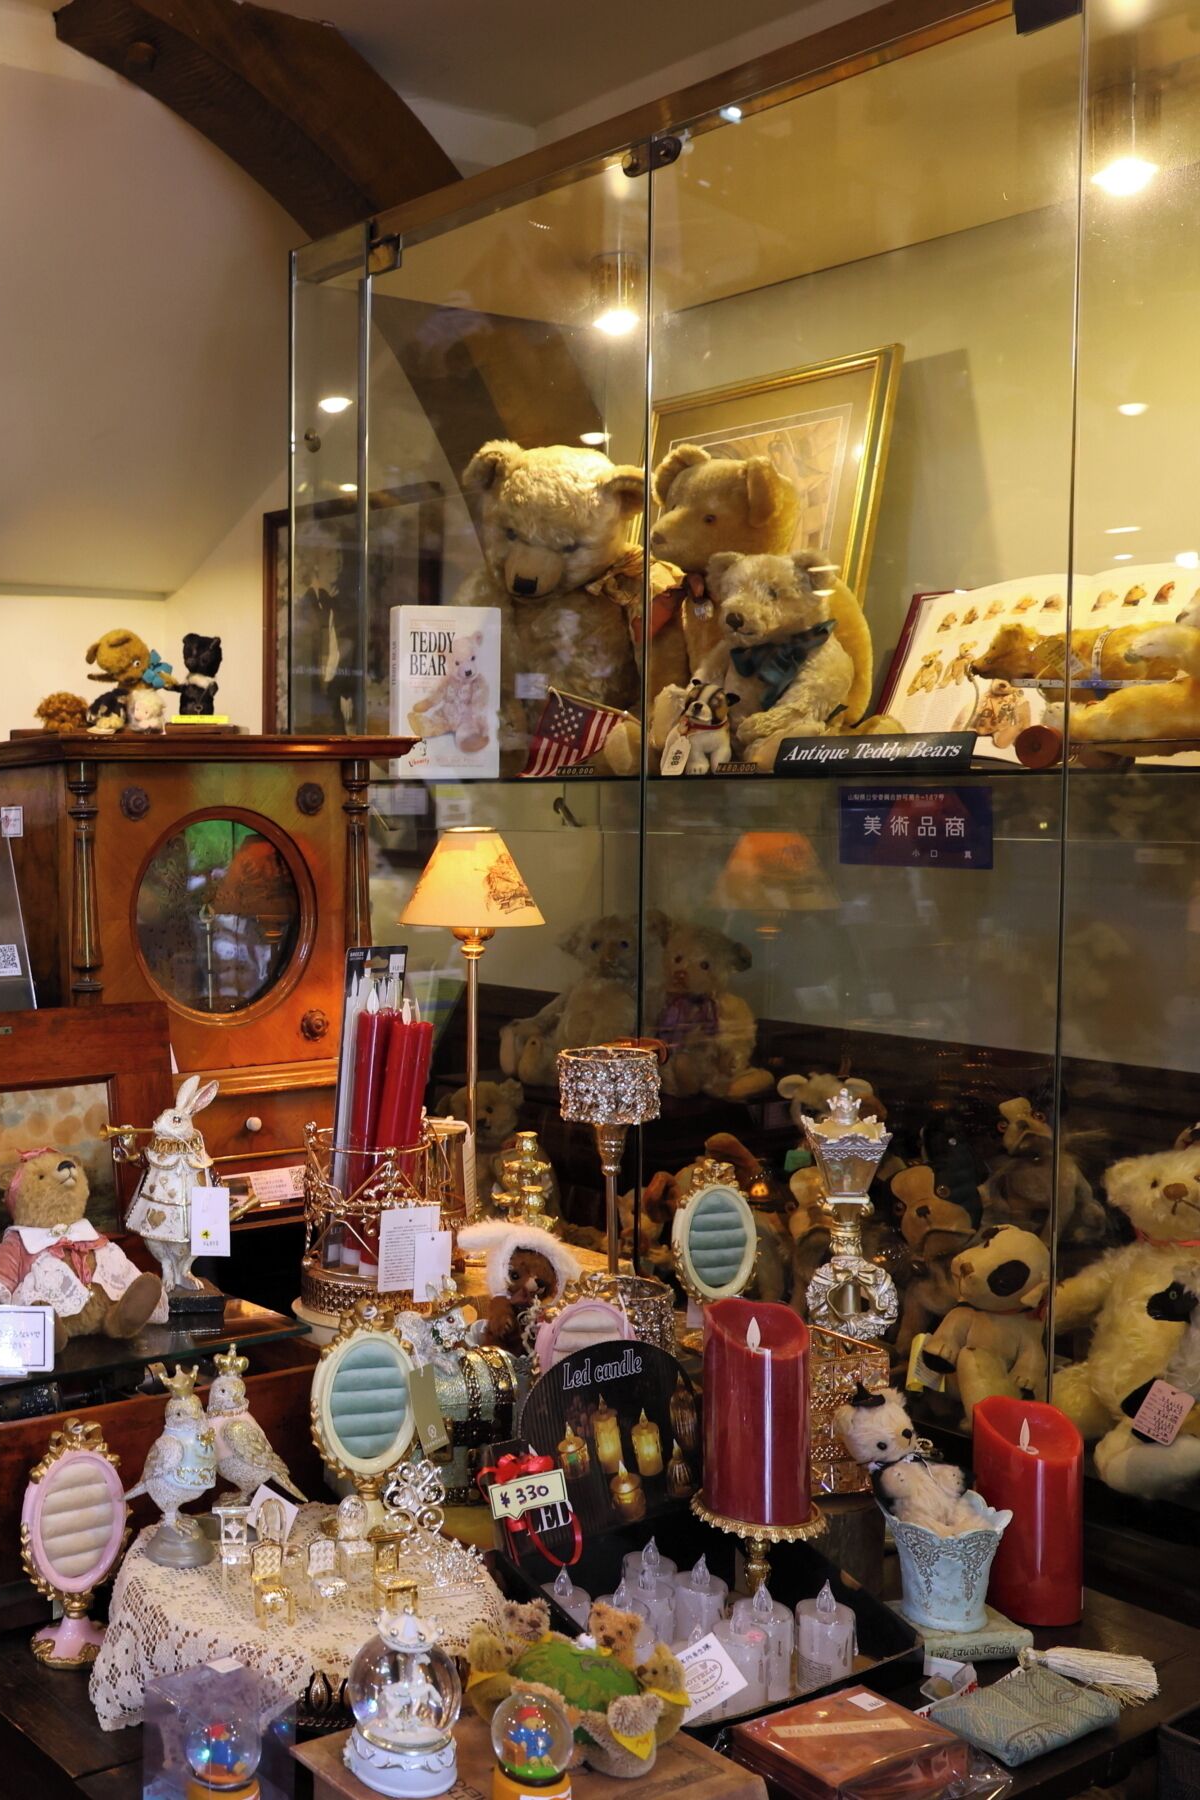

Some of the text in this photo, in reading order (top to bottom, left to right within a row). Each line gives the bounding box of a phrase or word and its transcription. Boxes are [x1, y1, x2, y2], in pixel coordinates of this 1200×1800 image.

[409, 631, 456, 653] TEDDY
[409, 654, 447, 676] BEAR
[783, 741, 962, 763] Antique Teddy Bears
[863, 815, 965, 838] 美術品商
[563, 1349, 643, 1390] Led candle
[515, 1484, 549, 1504] 330
[526, 1500, 573, 1536] LED
